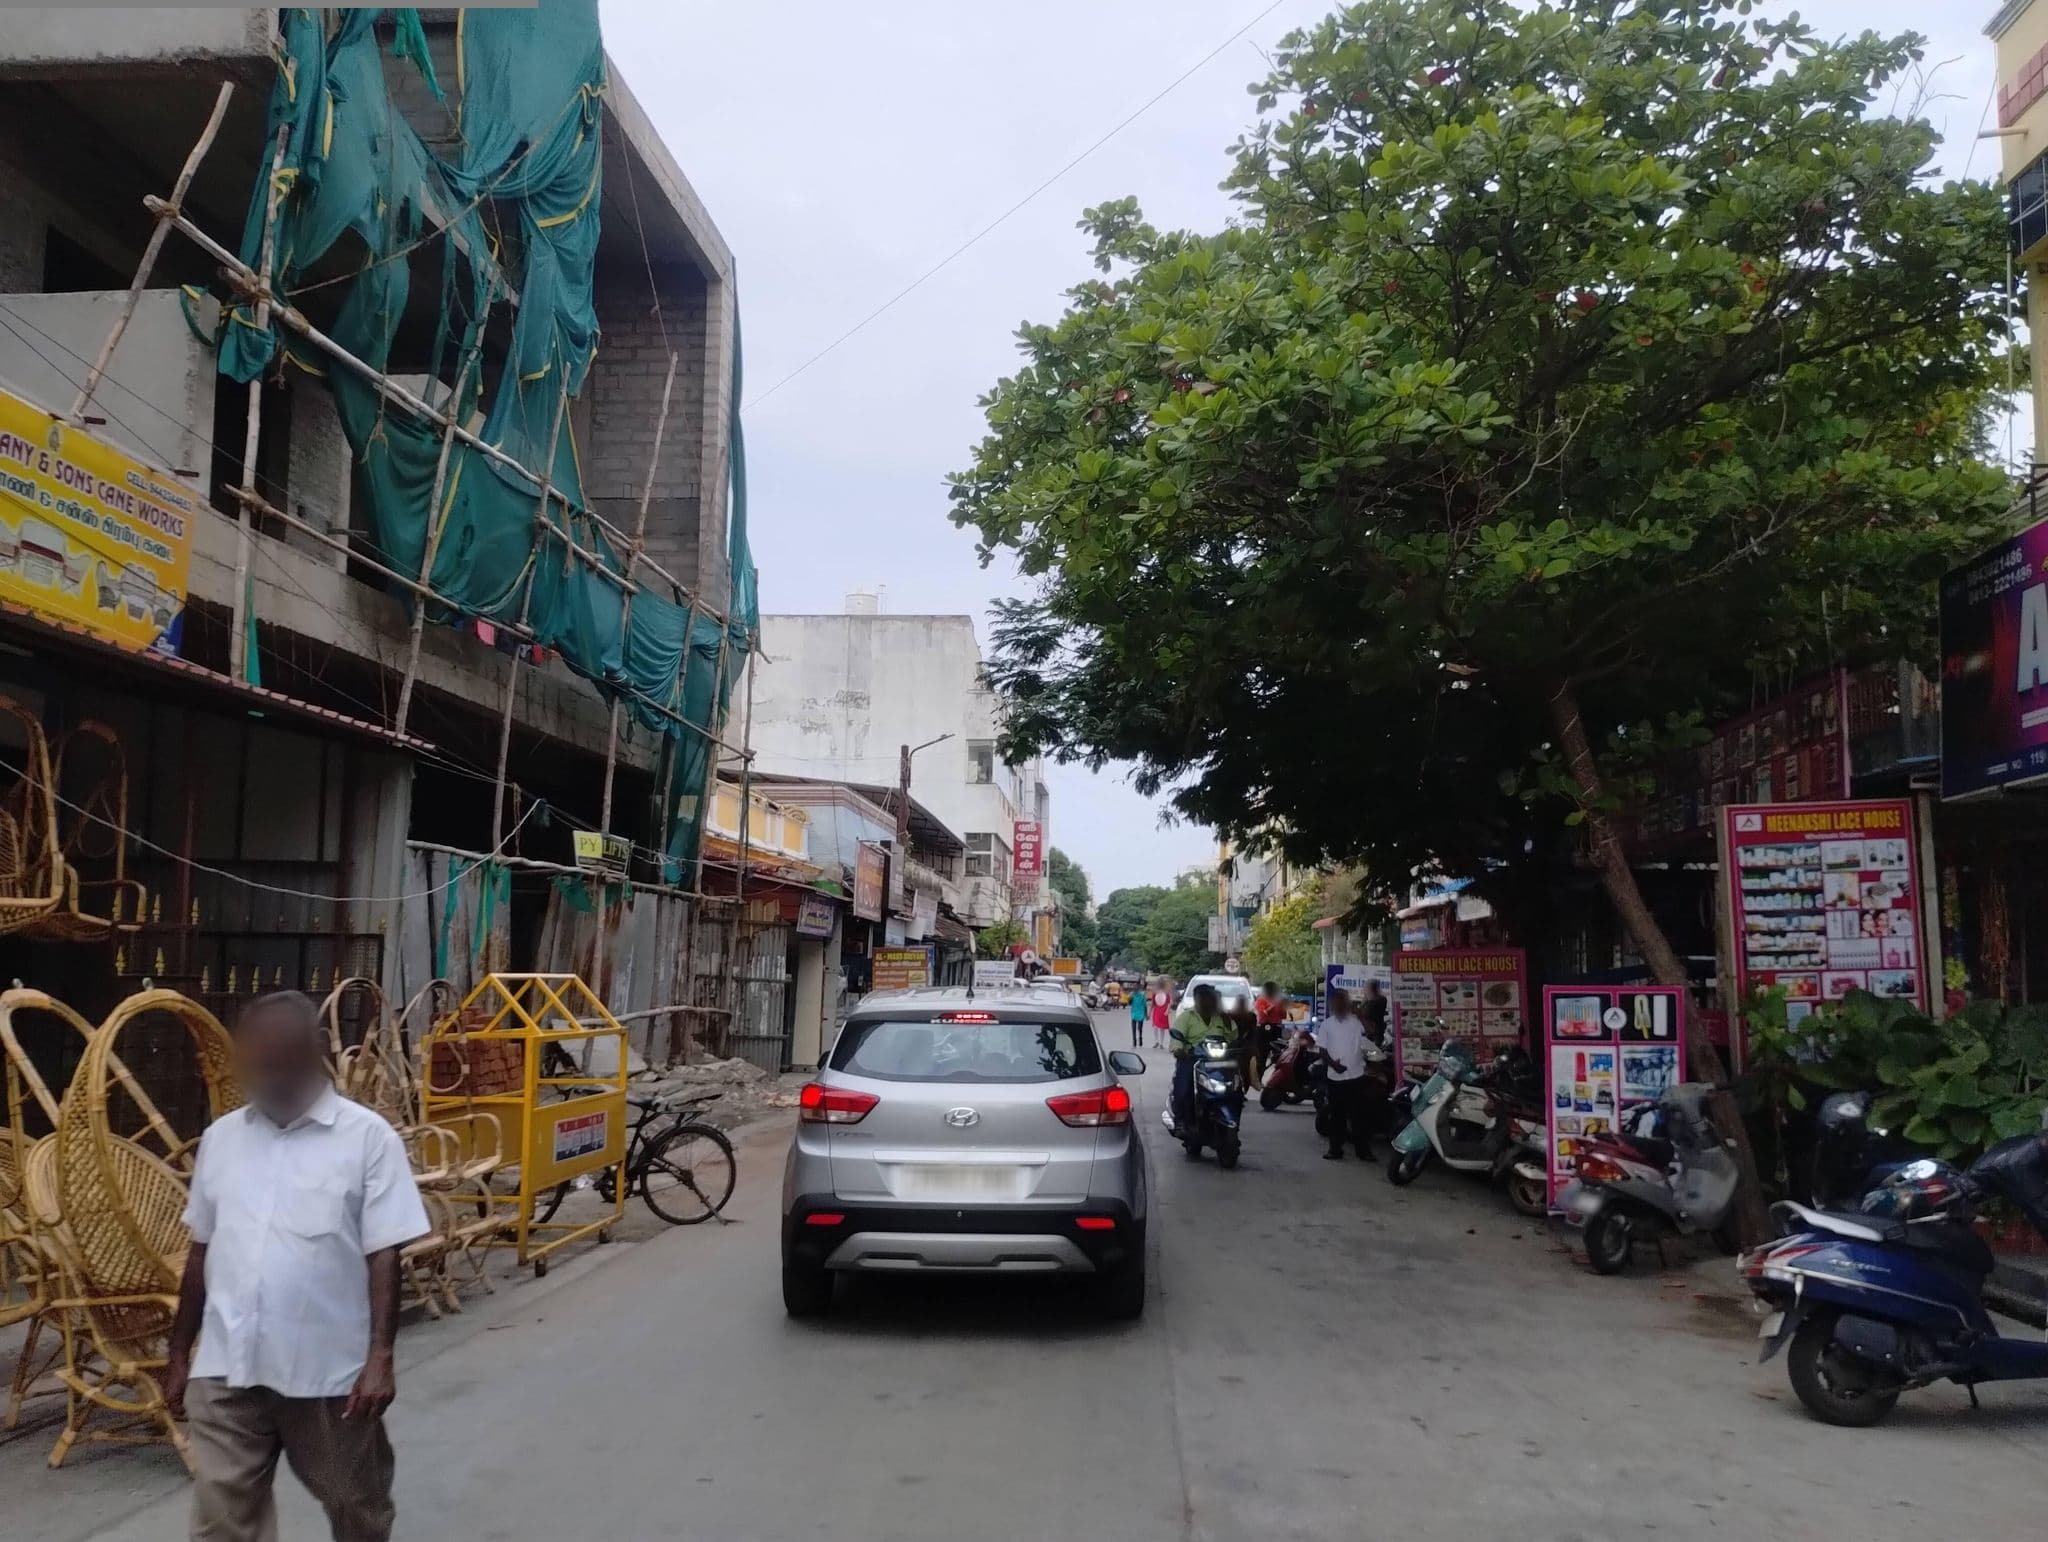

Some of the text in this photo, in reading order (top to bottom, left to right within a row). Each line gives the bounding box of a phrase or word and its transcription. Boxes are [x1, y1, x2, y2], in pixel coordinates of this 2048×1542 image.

[38, 452, 49, 473] &
[55, 460, 94, 494] SONS
[97, 481, 135, 514] CANE
[138, 502, 184, 537] WORKS
[1766, 809, 1902, 833] MEENAKSHI LACE HOUSE
[579, 837, 629, 859] PY LIFTS
[1398, 957, 1456, 973] MEENAKSHI
[1457, 957, 1482, 972] LACE
[1484, 956, 1519, 971] HOUSE
